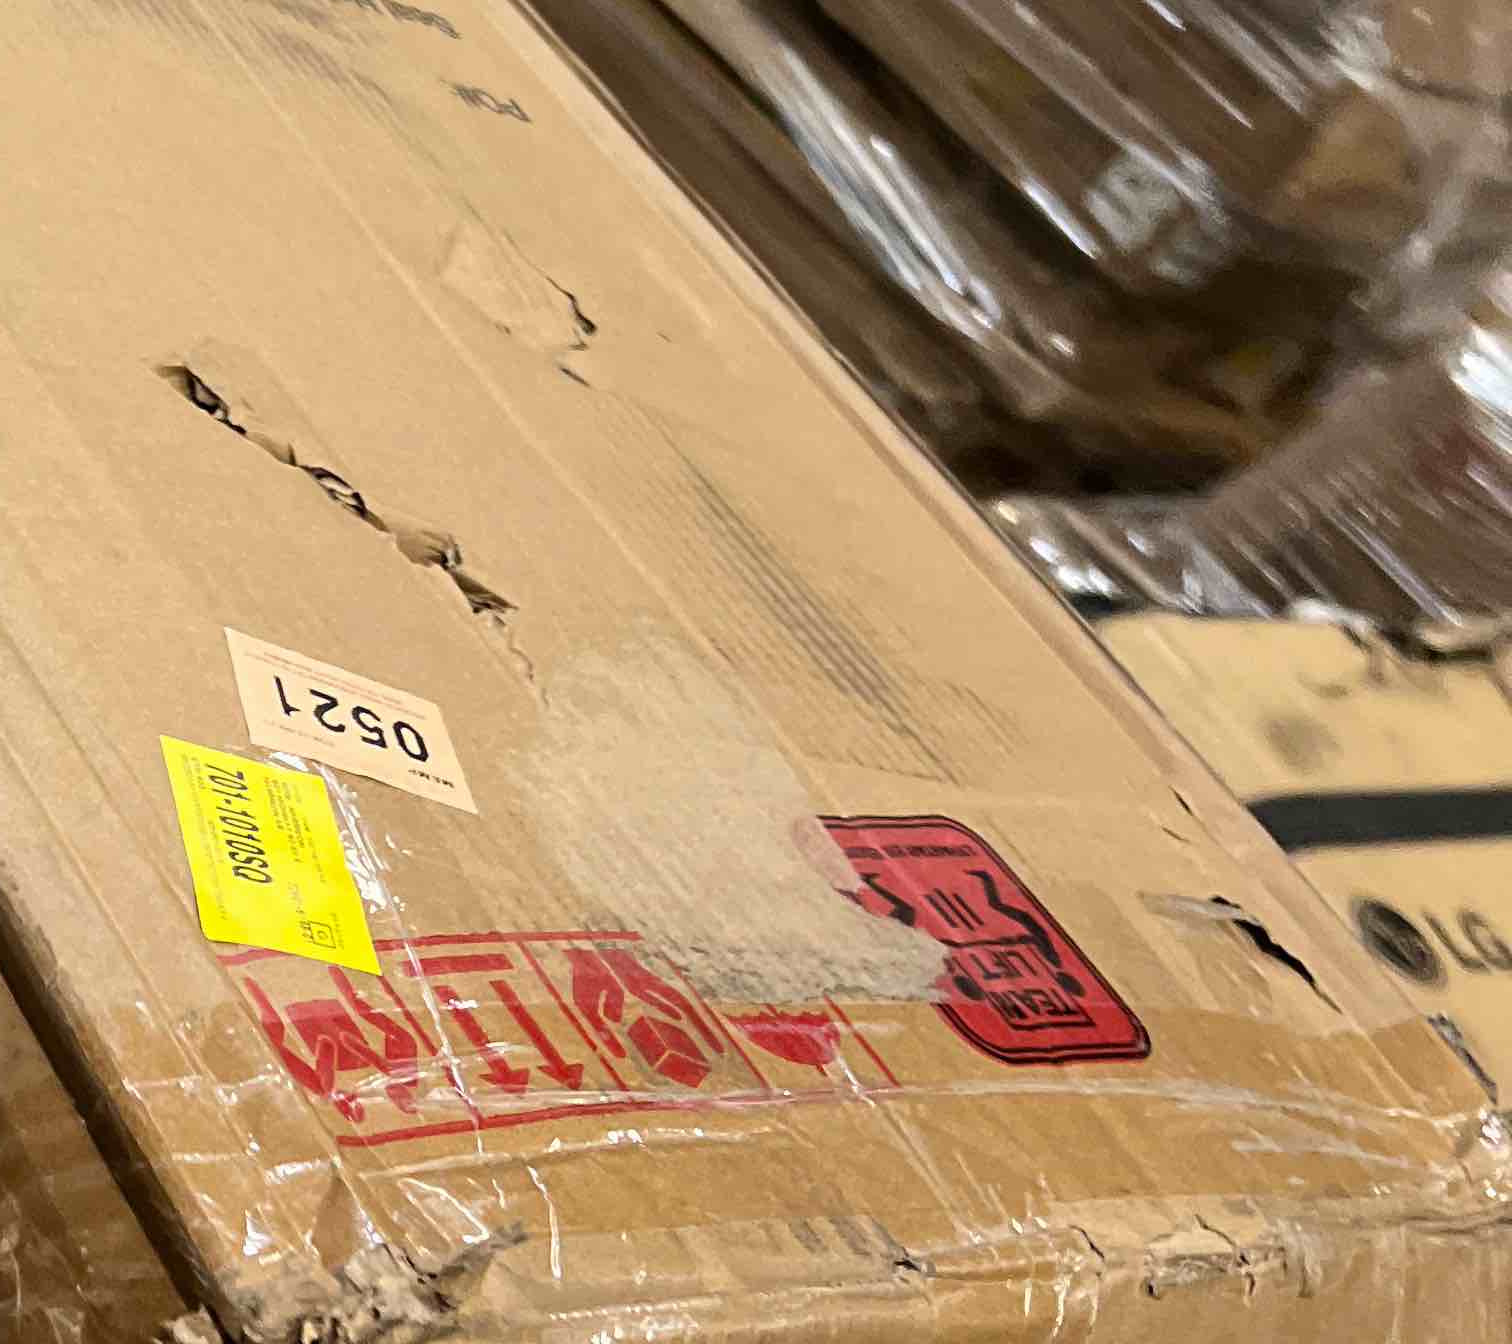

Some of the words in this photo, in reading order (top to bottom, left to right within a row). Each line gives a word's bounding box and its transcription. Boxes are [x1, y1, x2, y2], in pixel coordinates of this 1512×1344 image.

[274, 675, 430, 763] 0521
[968, 950, 1038, 980] LIFT
[989, 988, 1081, 1019] TEAM
